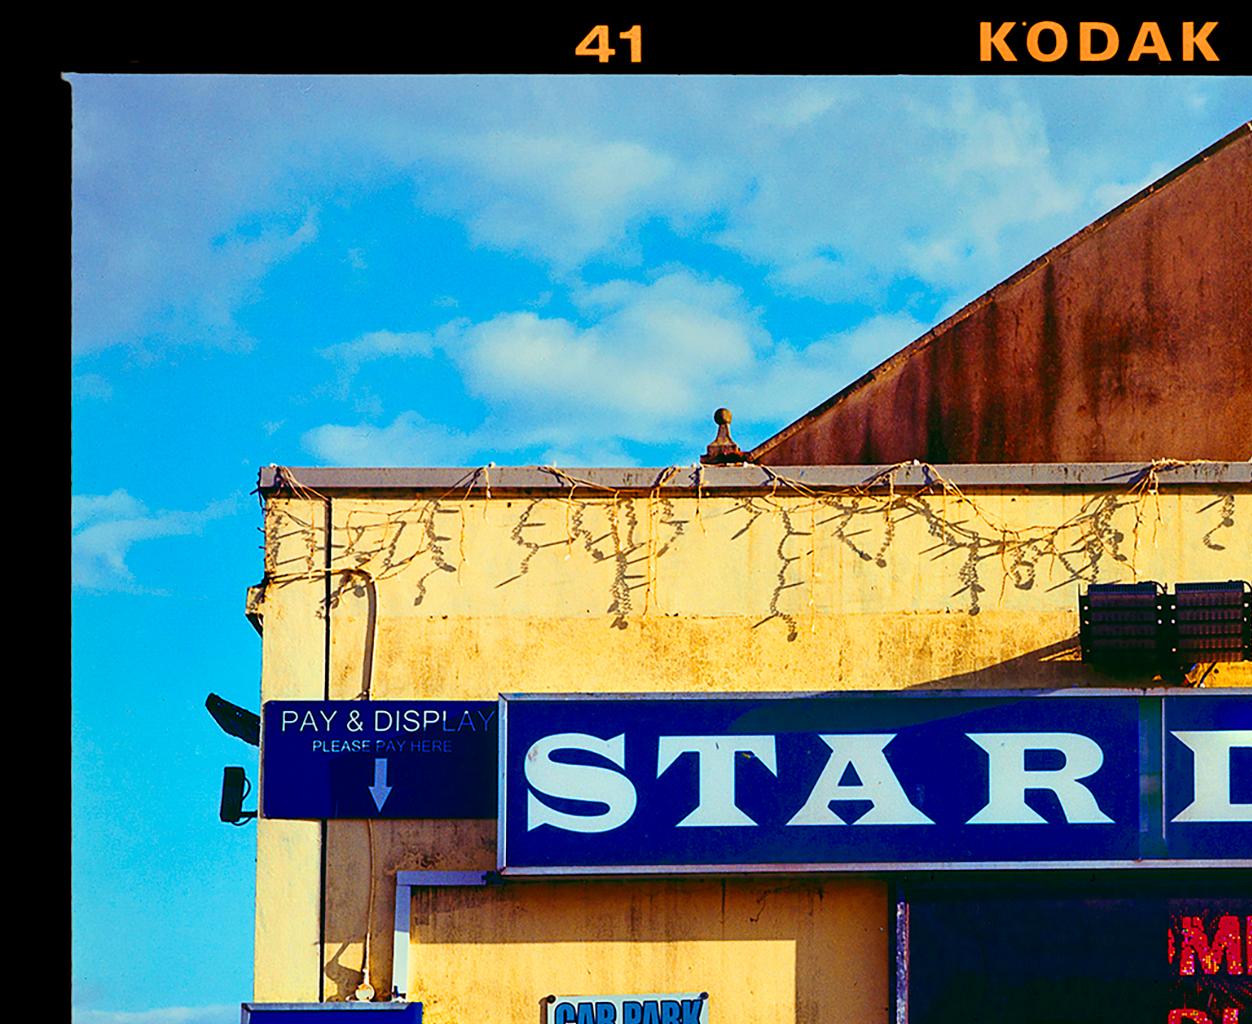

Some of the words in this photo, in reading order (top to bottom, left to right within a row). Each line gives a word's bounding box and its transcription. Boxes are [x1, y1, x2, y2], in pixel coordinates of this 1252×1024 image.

[282, 710, 338, 732] PAY
[346, 710, 364, 732] &
[374, 710, 496, 732] DISPLAY
[312, 740, 371, 752] PLEASE
[376, 740, 406, 752] PAY
[411, 740, 453, 752] HERE
